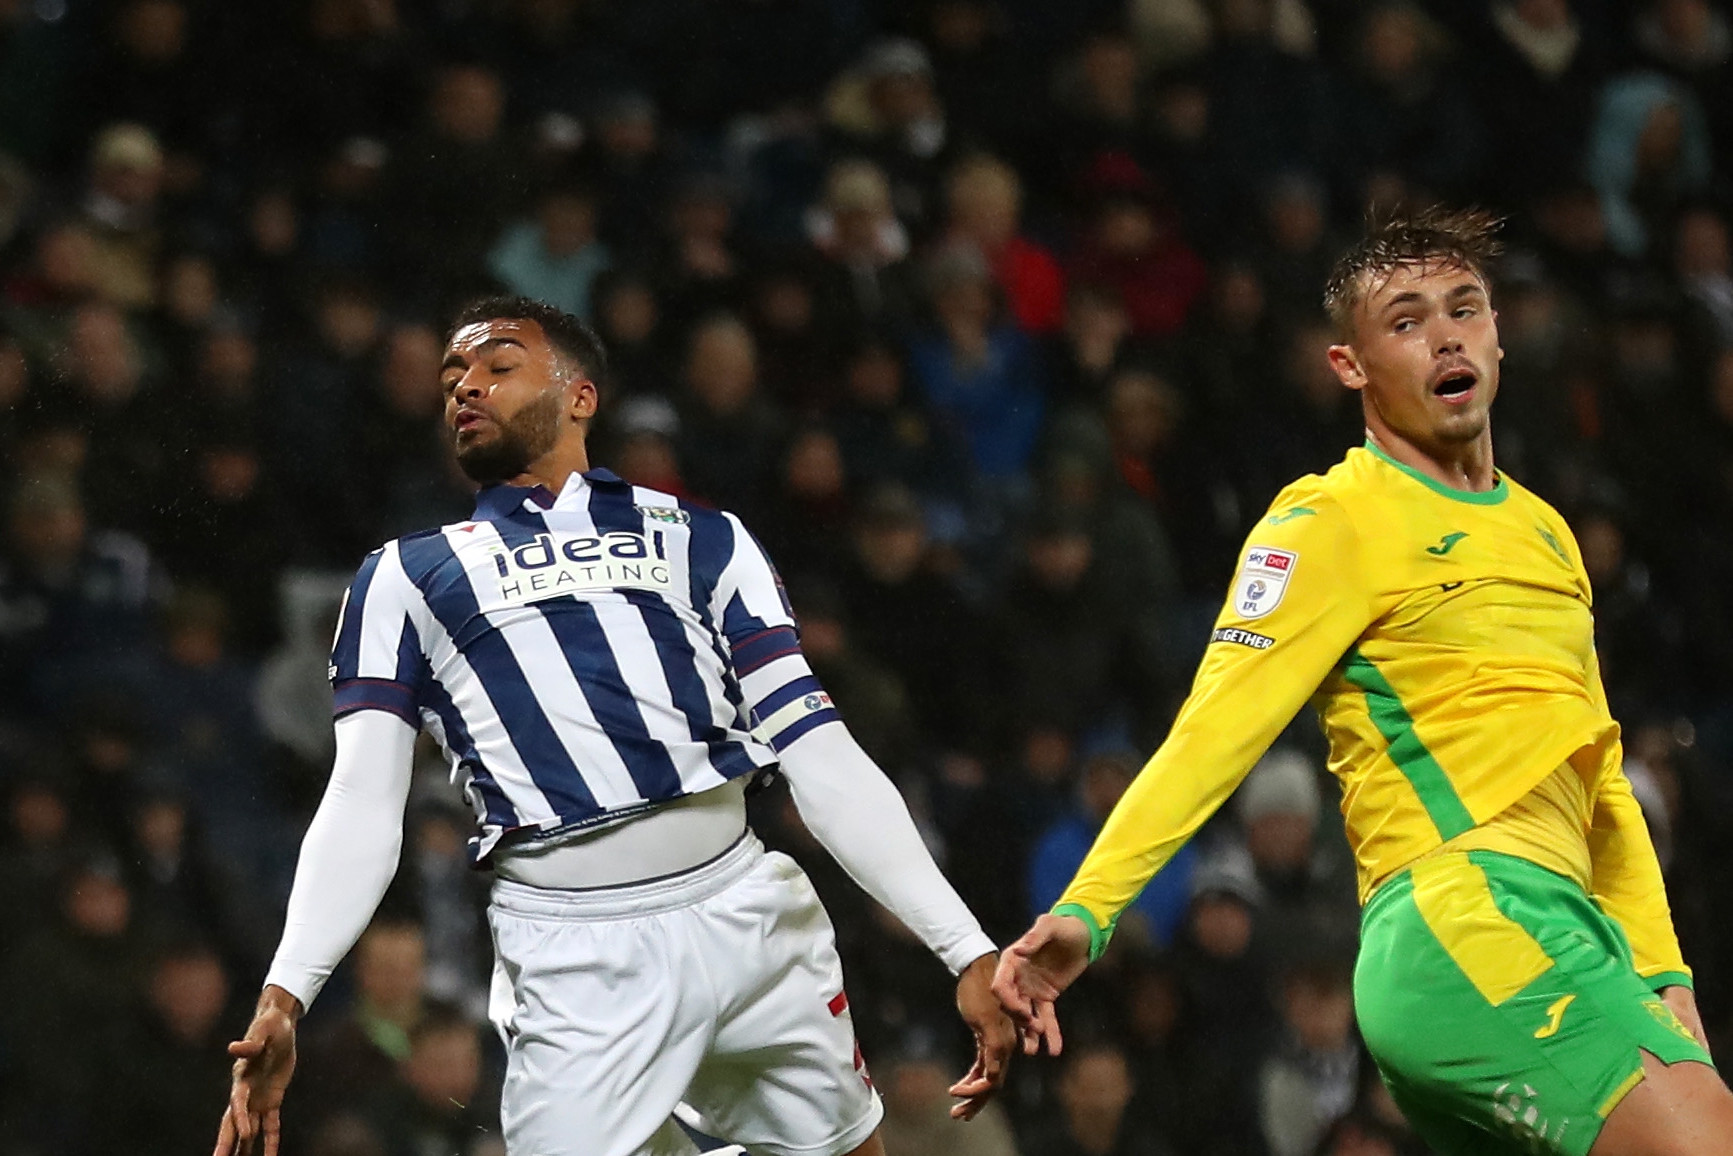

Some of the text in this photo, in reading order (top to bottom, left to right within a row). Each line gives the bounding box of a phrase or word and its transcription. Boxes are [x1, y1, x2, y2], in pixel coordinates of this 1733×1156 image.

[493, 530, 667, 578] ideal
[1247, 552, 1287, 569] sky bet
[502, 564, 669, 600] HEATING
